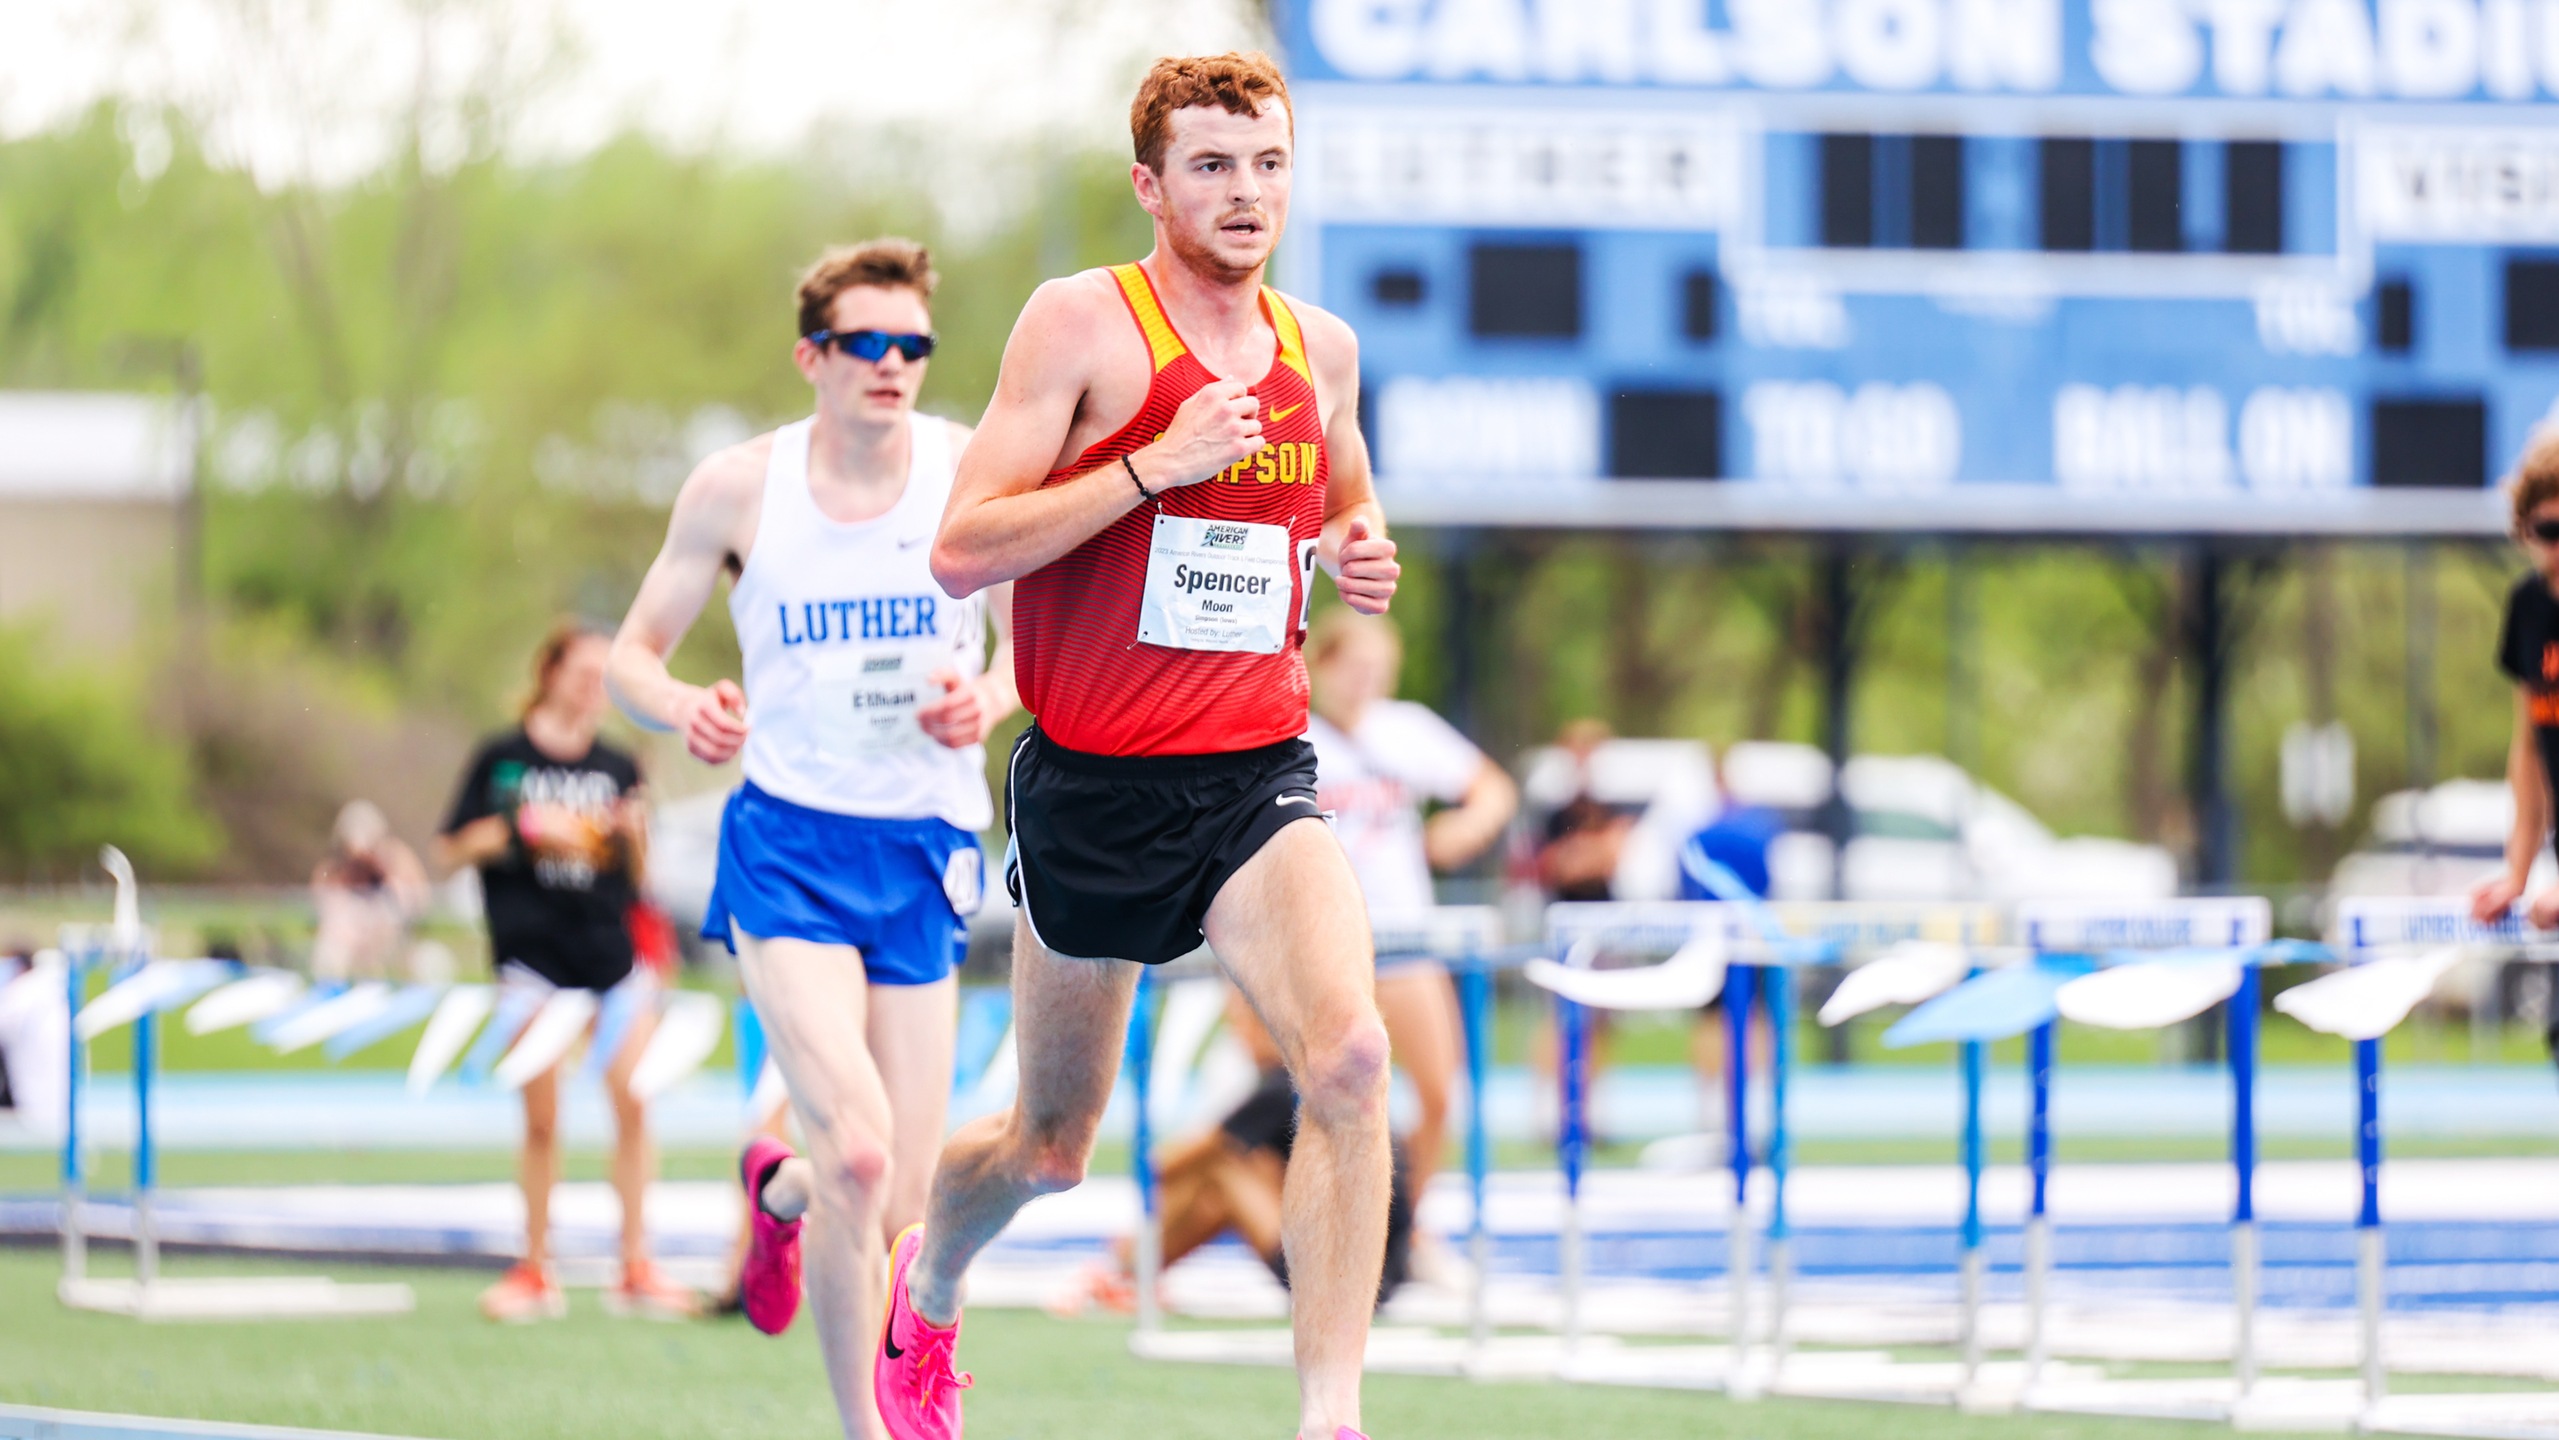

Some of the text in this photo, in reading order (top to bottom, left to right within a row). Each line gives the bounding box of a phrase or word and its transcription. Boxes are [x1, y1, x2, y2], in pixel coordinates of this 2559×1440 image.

[1308, 0, 2559, 99] CARLSON STADI
[1207, 524, 1249, 535] AMERICAN
[1174, 563, 1271, 595] Spencer
[1202, 599, 1233, 613] Moon
[778, 596, 936, 645] LUTHER
[1185, 625, 1209, 637] Hosted
[1221, 629, 1243, 639] Luther
